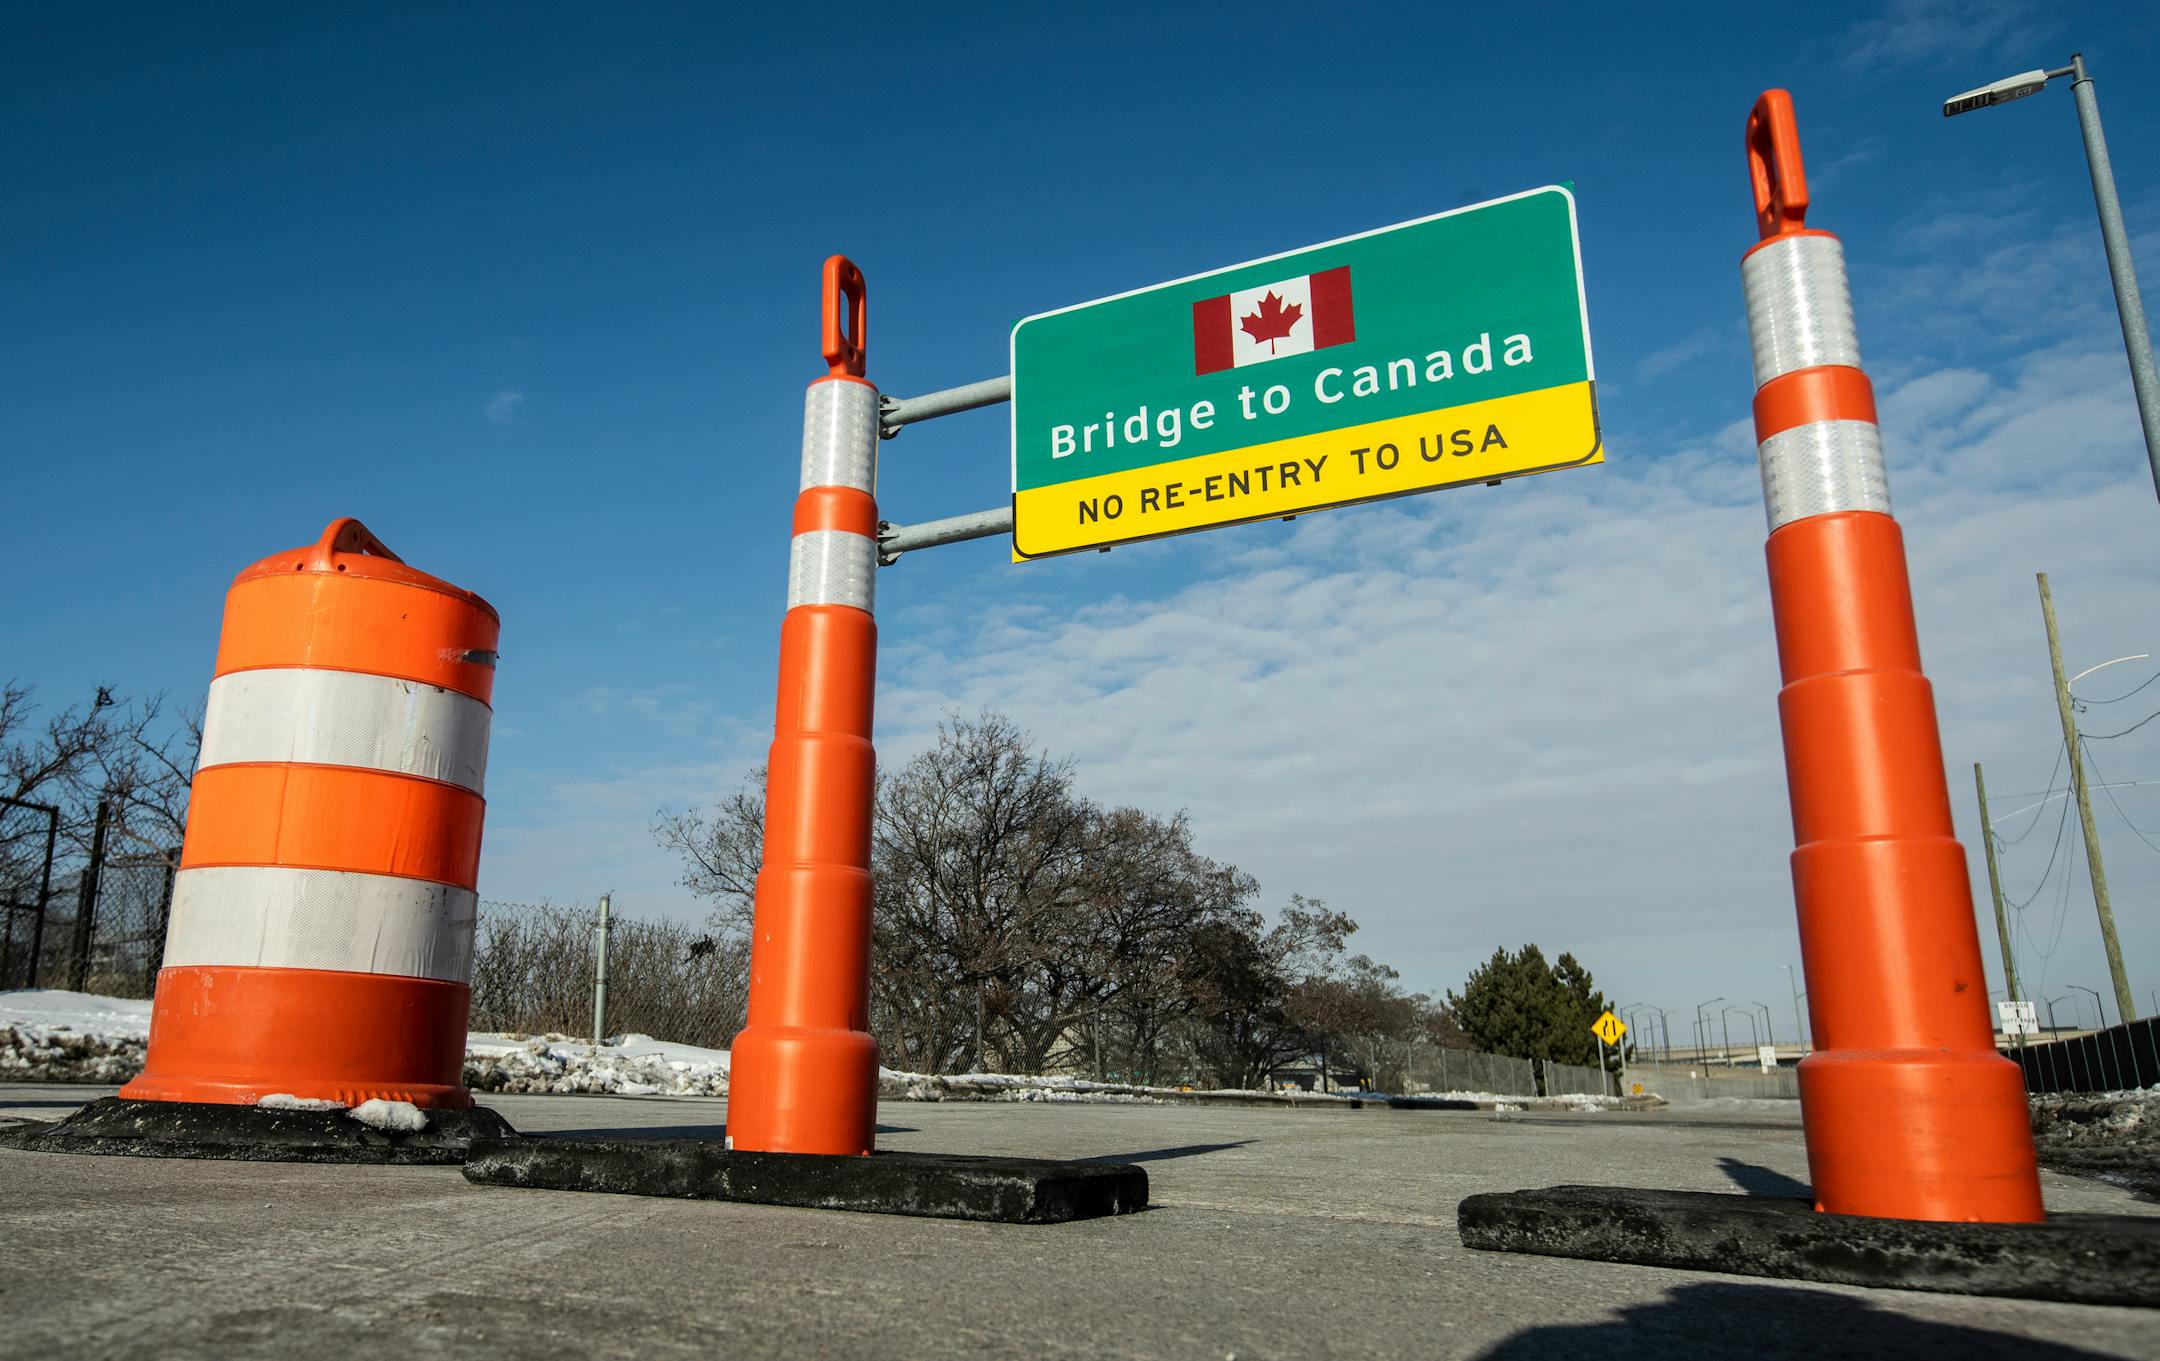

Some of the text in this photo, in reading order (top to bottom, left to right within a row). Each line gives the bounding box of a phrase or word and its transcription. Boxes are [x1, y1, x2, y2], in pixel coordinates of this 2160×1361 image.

[1051, 332, 1534, 459] Bridge to Canada
[1079, 424, 1508, 525] NO RE-ENTRY TO USA
